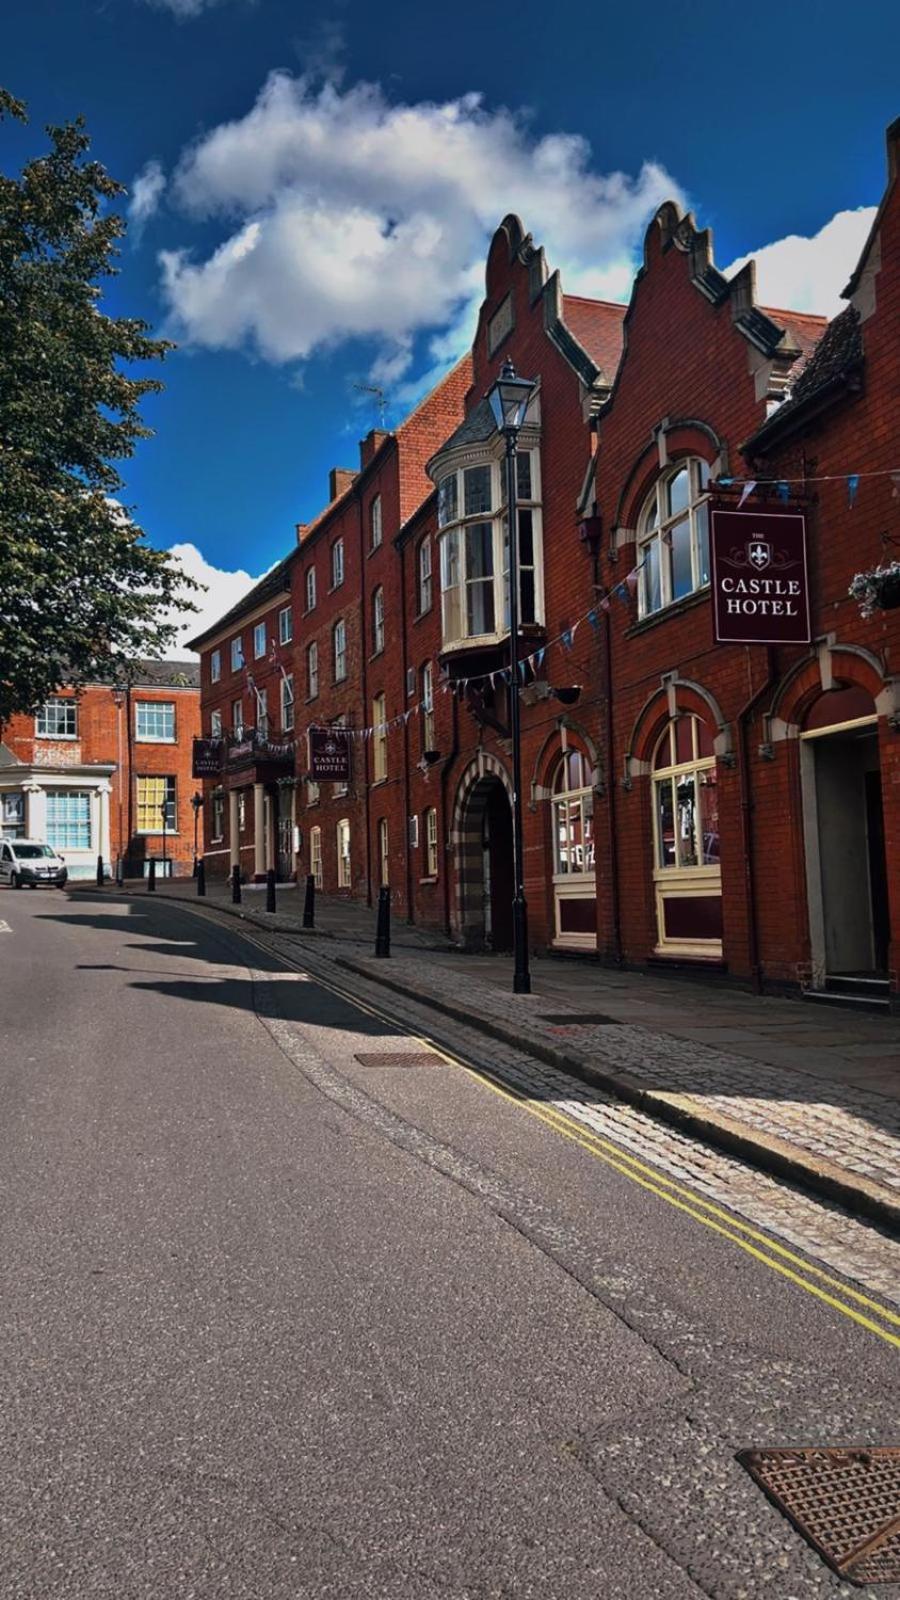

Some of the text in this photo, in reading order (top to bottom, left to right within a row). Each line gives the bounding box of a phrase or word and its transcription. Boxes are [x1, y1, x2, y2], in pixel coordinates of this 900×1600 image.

[721, 578, 801, 595] CASTLE
[726, 599, 797, 616] HOTEL
[315, 764, 346, 772] HOTEL
